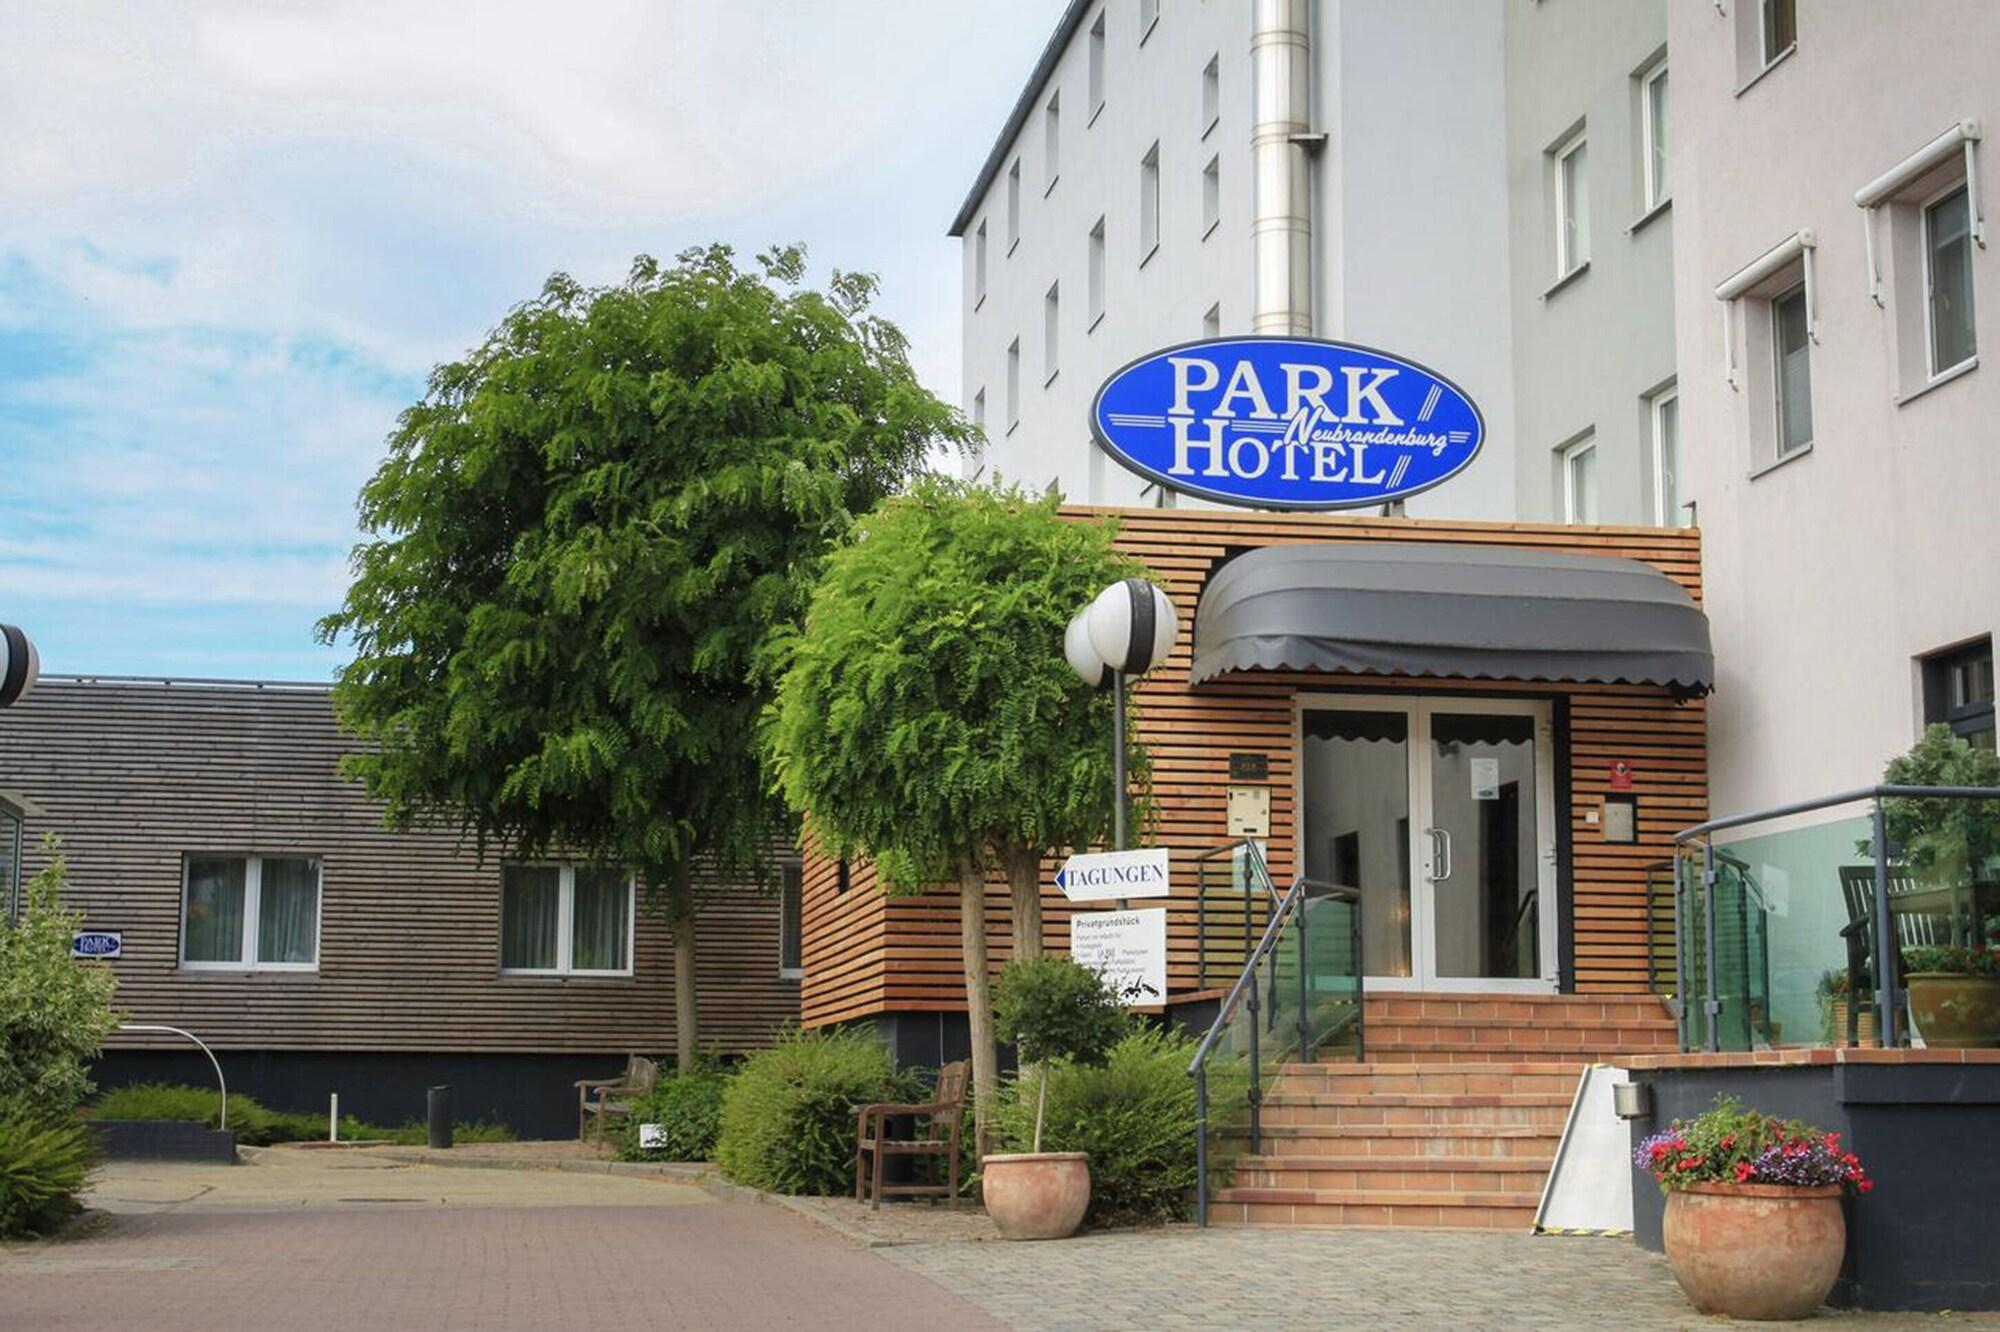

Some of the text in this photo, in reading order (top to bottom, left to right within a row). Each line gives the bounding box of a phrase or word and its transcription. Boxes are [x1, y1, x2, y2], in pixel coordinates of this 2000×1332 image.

[1167, 356, 1404, 426] PARK
[1283, 406, 1448, 456] Neubrandenburg
[1167, 417, 1386, 485] HOTEL
[1067, 864, 1164, 887] TAGUNGEN
[1076, 915, 1140, 929] Privatgrundstück
[80, 936, 111, 945] PARK
